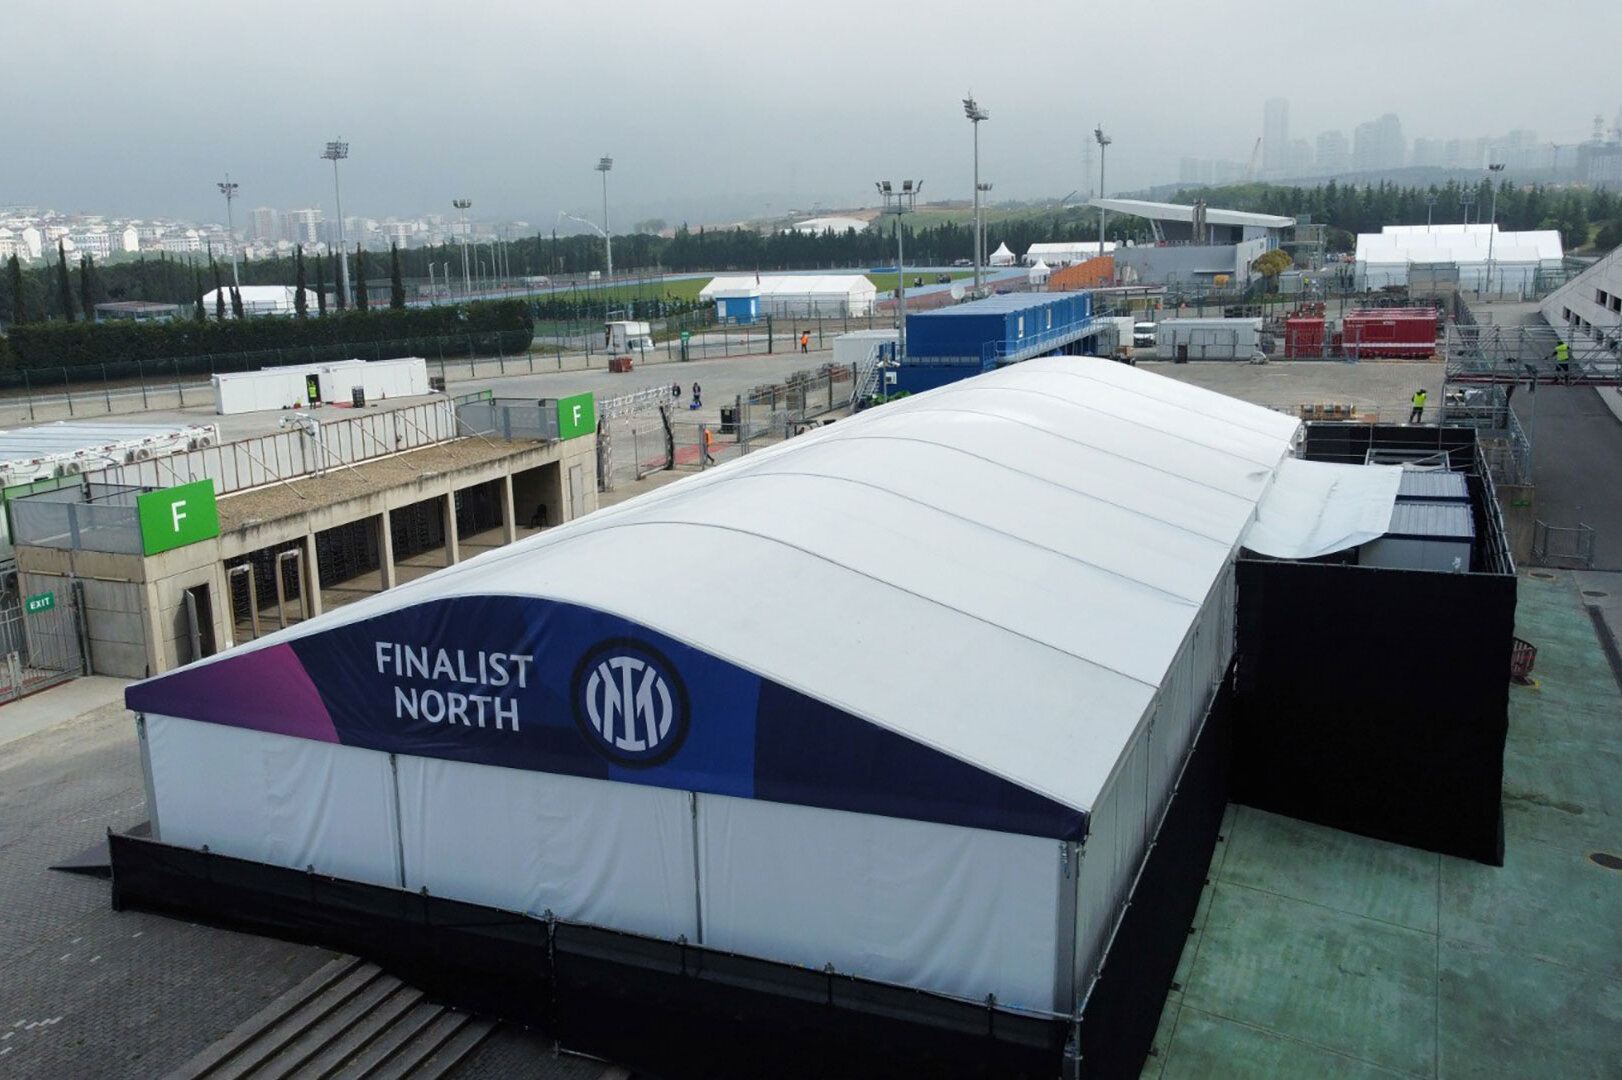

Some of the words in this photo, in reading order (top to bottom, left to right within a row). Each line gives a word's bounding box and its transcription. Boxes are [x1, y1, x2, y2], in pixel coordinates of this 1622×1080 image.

[573, 405, 582, 427] F
[171, 500, 187, 532] F
[29, 597, 50, 610] EXIT
[375, 641, 533, 689] FINALIST
[394, 686, 519, 732] NORTH
